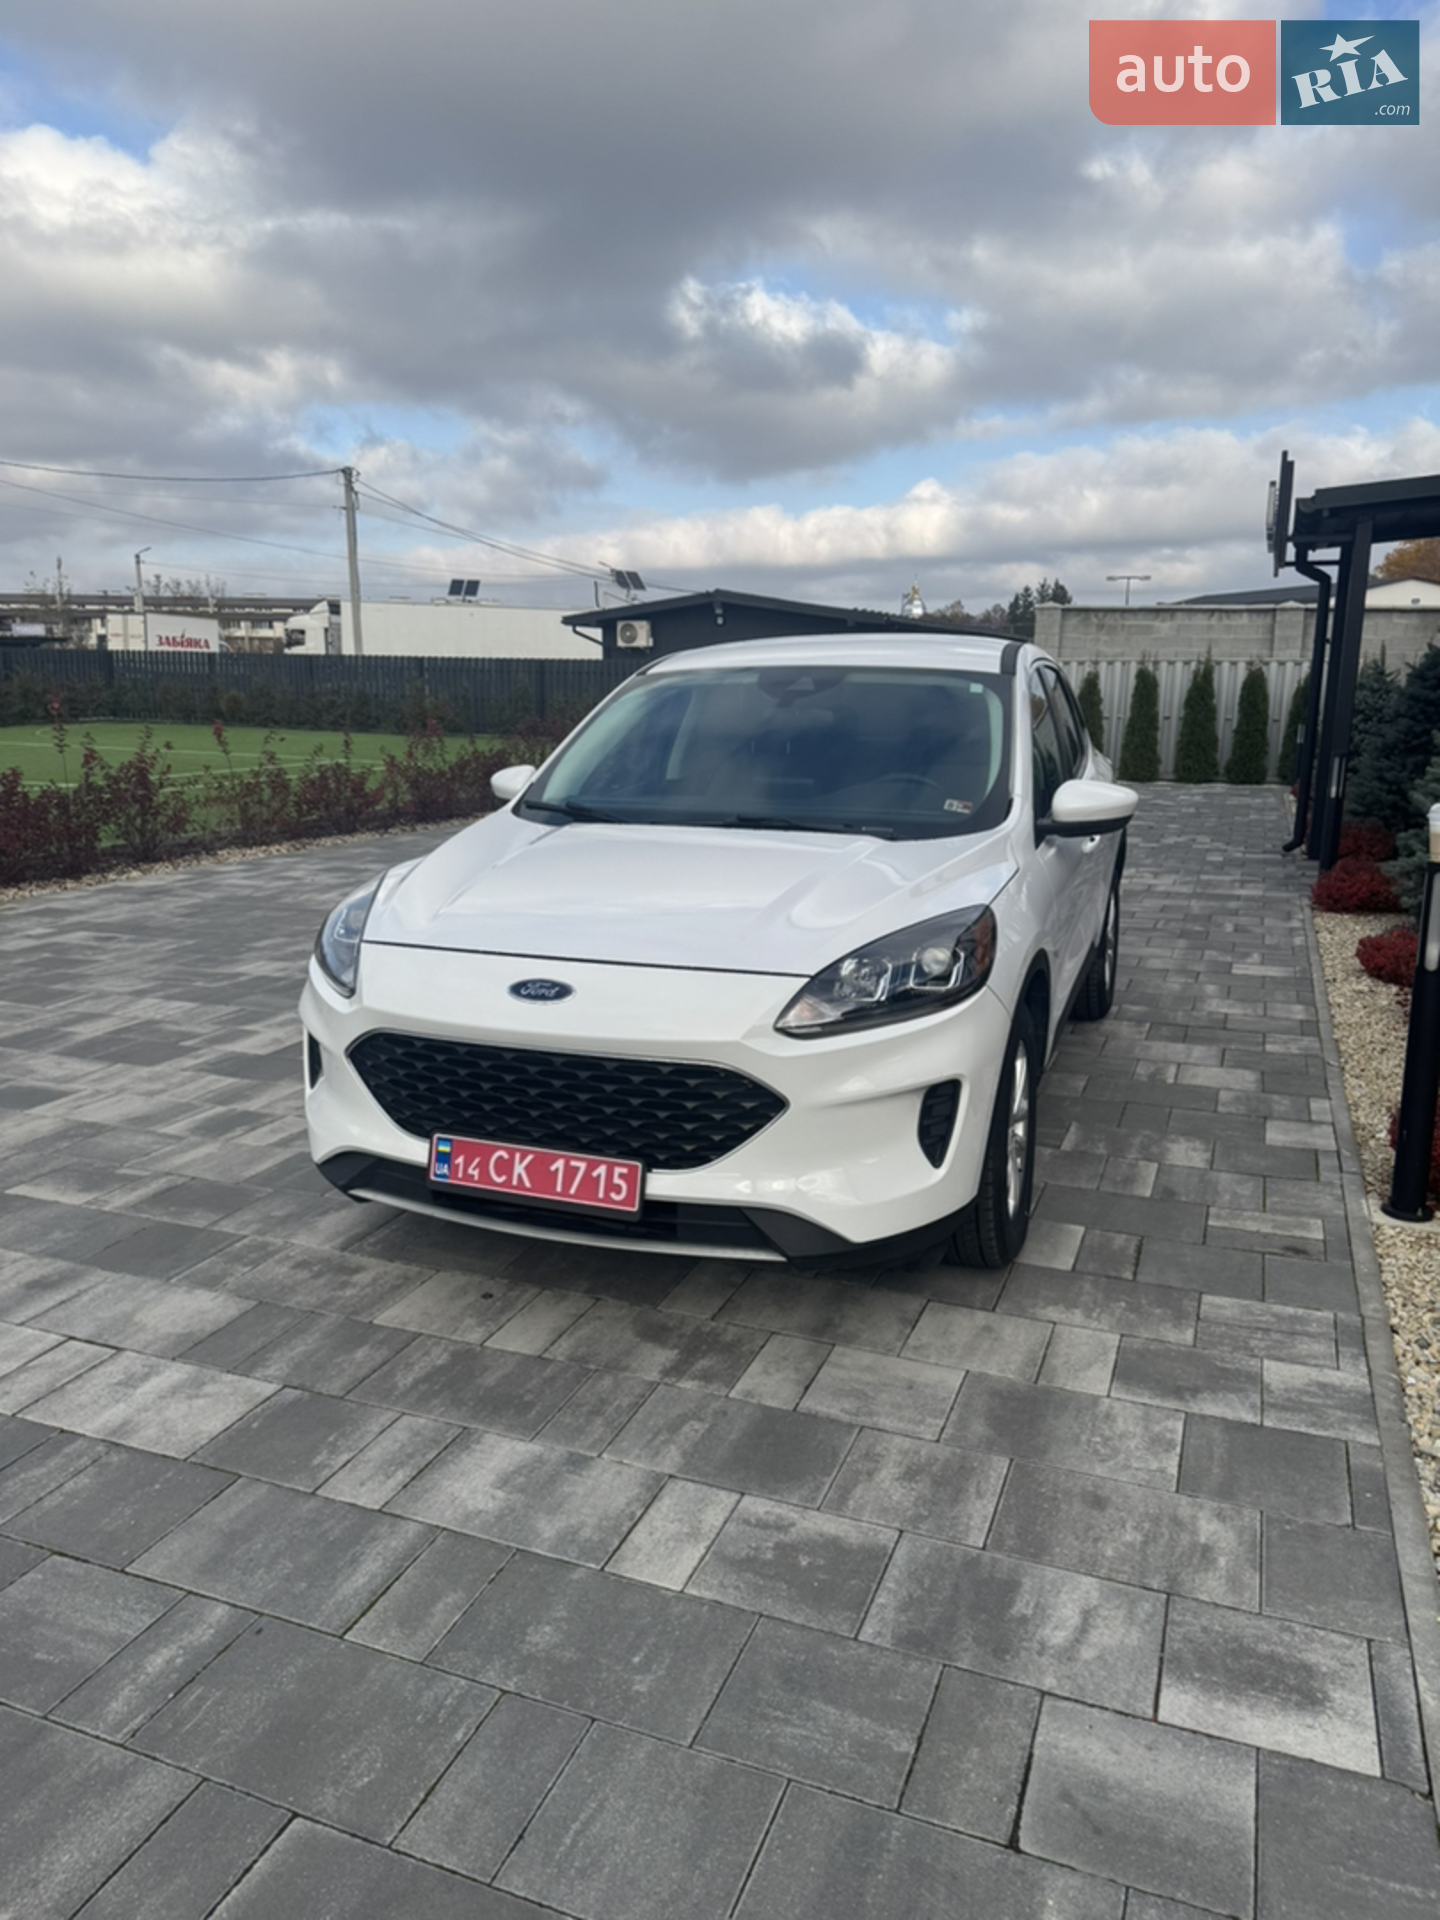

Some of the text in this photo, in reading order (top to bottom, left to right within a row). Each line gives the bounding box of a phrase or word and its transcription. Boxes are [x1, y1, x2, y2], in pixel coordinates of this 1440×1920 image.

[156, 631, 211, 650] ЗАБІЯКА
[520, 981, 560, 998] Ford
[435, 1162, 450, 1176] UA
[454, 1150, 629, 1201] 14 CK 1715
